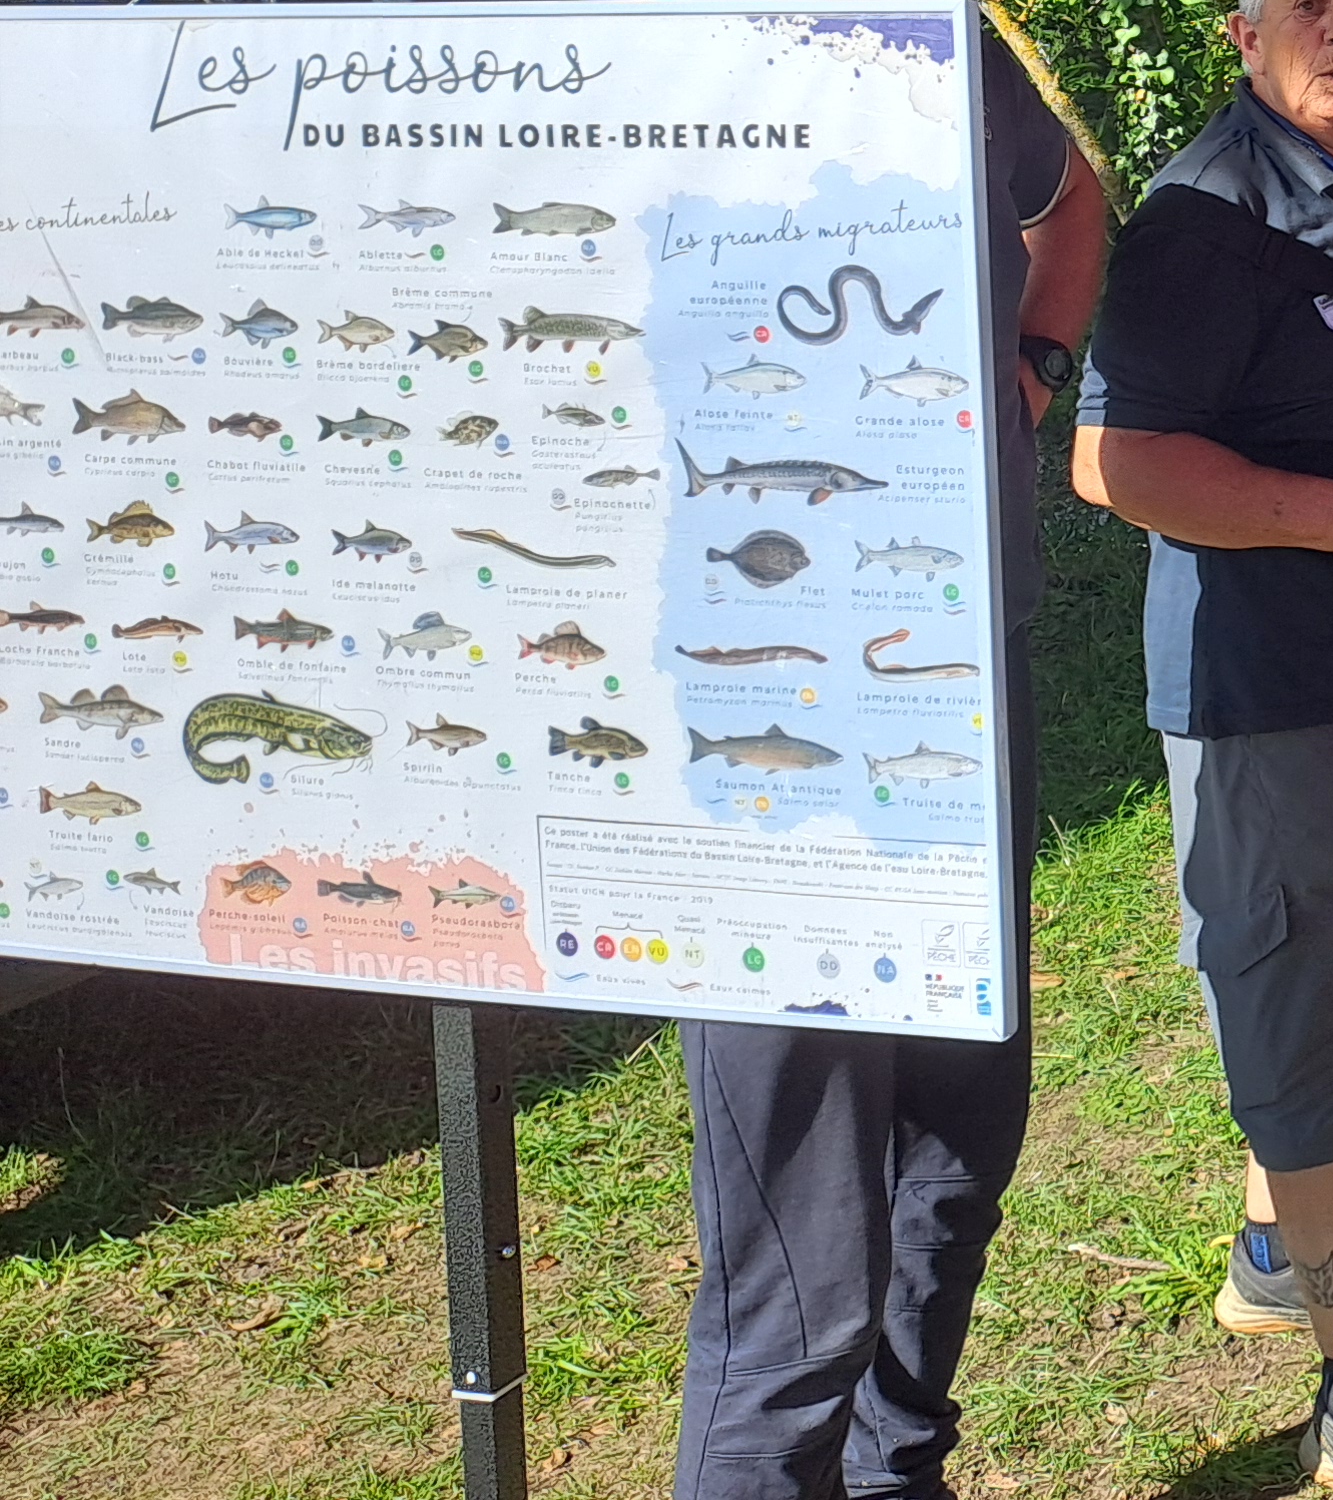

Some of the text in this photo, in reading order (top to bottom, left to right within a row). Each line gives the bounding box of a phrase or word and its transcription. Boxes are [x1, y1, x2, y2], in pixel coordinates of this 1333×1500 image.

[150, 18, 612, 152] Les poissons
[303, 123, 812, 150] DU BASSIN LOIRE-BRETAGNE
[661, 199, 963, 267] Les grands migrateurs
[217, 248, 305, 259] Able de Heckel
[359, 250, 403, 260] Ablette
[490, 252, 569, 262] Amour Blanc
[711, 280, 767, 294] Anguille
[434, 289, 493, 299] commune
[690, 293, 768, 307] européenne
[1, 350, 40, 361] arbeau
[224, 356, 274, 367] Bouvière
[523, 363, 571, 374] Brochet
[694, 409, 774, 421] Alose feinte
[855, 415, 945, 428] Grande alose
[18, 438, 62, 450] argenté
[84, 454, 177, 467] Carpe commune
[207, 459, 306, 473] Chabot fluviatile
[324, 464, 381, 476] Chevesne
[424, 468, 523, 481] Crapet de roche
[896, 464, 965, 478] Esturgeon
[901, 479, 966, 493] européen
[210, 570, 239, 582] Hotu
[332, 578, 351, 589] Ide
[506, 585, 628, 601] Lamproie de planer
[800, 585, 826, 597] Flet
[851, 587, 925, 601] Mulet porc
[36, 646, 80, 658] Franche
[123, 651, 147, 663] Lote
[237, 658, 347, 674] Omble de fontaine
[376, 665, 472, 680] Ombre commun
[515, 672, 557, 685] Perche
[686, 681, 797, 697] Lamproie marine
[857, 690, 982, 707] Lamproie de rivièr
[44, 737, 82, 750] Sandre
[403, 762, 443, 775] Spirlin
[290, 774, 325, 786] Silure
[547, 770, 591, 783] Tanche
[715, 777, 841, 797] Saumon Atantique
[903, 796, 942, 810] Truite
[948, 798, 964, 811] de
[49, 829, 114, 844] Truite fario
[544, 826, 557, 837] Ce
[560, 829, 589, 841] poster
[601, 829, 618, 841] été
[620, 831, 654, 844] réalisé
[657, 834, 679, 846] avec
[682, 836, 693, 846] le
[695, 837, 731, 849] soutien
[734, 839, 776, 853] financier
[780, 843, 792, 854] de
[795, 844, 806, 855] la
[809, 844, 862, 859] Fédération
[865, 848, 914, 861] Nationale
[917, 851, 930, 862] de
[933, 853, 944, 863] la
[613, 845, 631, 856] des
[632, 843, 688, 860] Fédérations
[690, 850, 703, 861] du
[704, 850, 736, 863] Bassin
[813, 858, 824, 869] et
[825, 859, 868, 873] l'Agence
[870, 862, 883, 874] de
[548, 884, 579, 896] Statut
[609, 889, 632, 901] pour
[634, 890, 644, 901] la
[646, 892, 681, 904] France
[690, 895, 714, 906] 2019
[25, 907, 76, 923] Vandoise
[143, 904, 195, 919] Vandoise
[716, 917, 788, 931] Préoccupation
[803, 924, 848, 936] Données
[873, 929, 894, 939] Non
[559, 939, 575, 950] RE
[596, 941, 613, 953] CR
[793, 934, 859, 948] insuffisantes
[865, 940, 903, 952] analysé
[648, 946, 666, 957] VU
[684, 949, 701, 960] NT
[229, 931, 528, 992] Les invasifs
[819, 959, 839, 972] DD
[596, 974, 619, 985] Eaux
